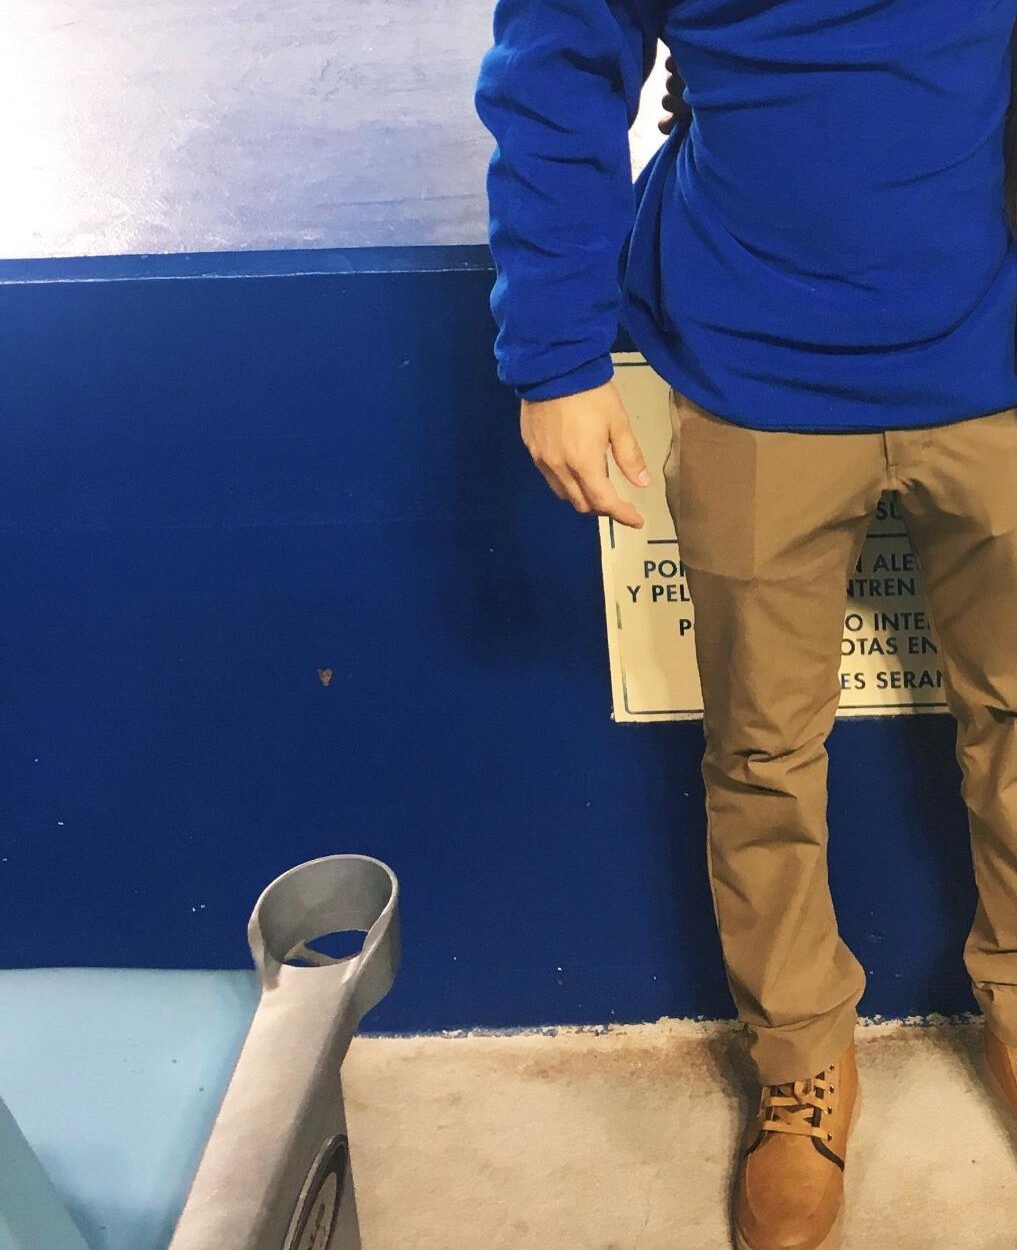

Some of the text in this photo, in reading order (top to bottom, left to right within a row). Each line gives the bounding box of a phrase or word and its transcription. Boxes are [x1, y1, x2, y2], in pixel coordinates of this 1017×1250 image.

[872, 553, 917, 573] ALE
[626, 584, 642, 603] Y
[873, 612, 931, 631] INTE
